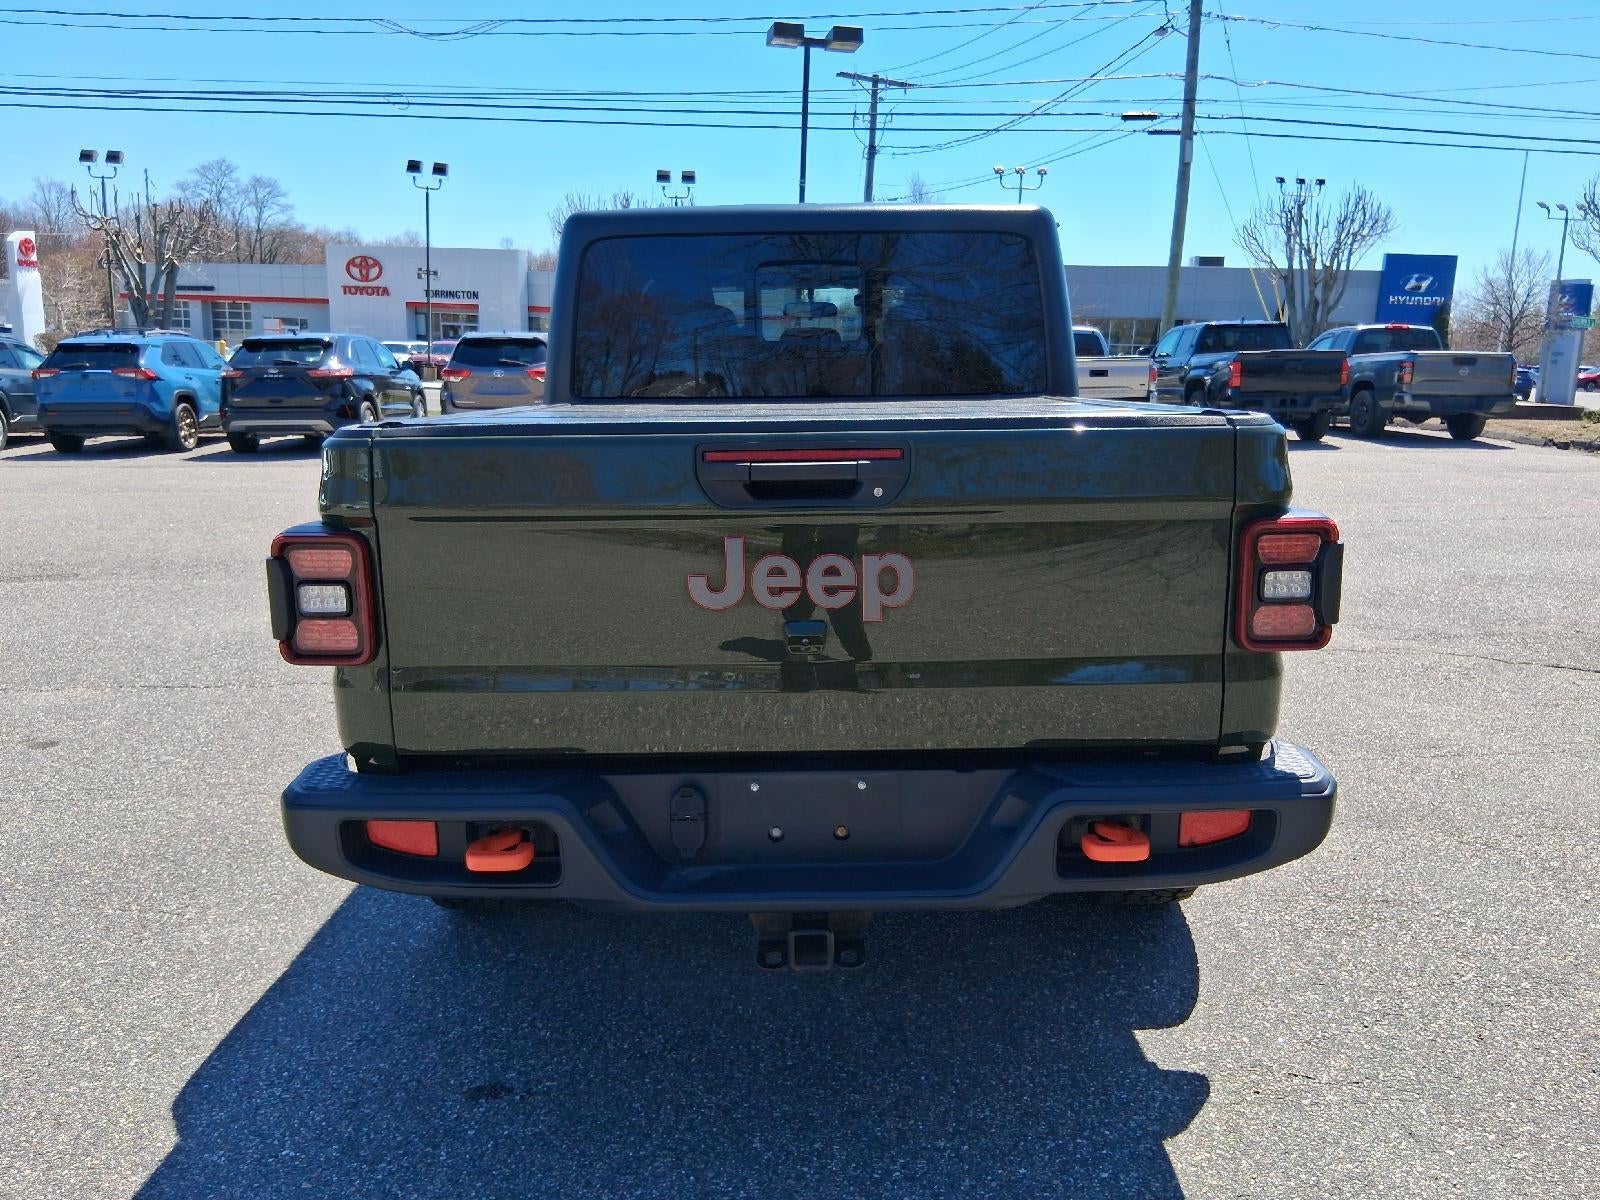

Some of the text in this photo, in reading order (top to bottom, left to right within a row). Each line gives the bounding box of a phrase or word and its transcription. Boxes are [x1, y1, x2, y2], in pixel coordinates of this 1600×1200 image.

[341, 285, 390, 297] TOYOTA
[1389, 295, 1445, 306] HYUNDAI
[687, 536, 916, 622] Jeep
